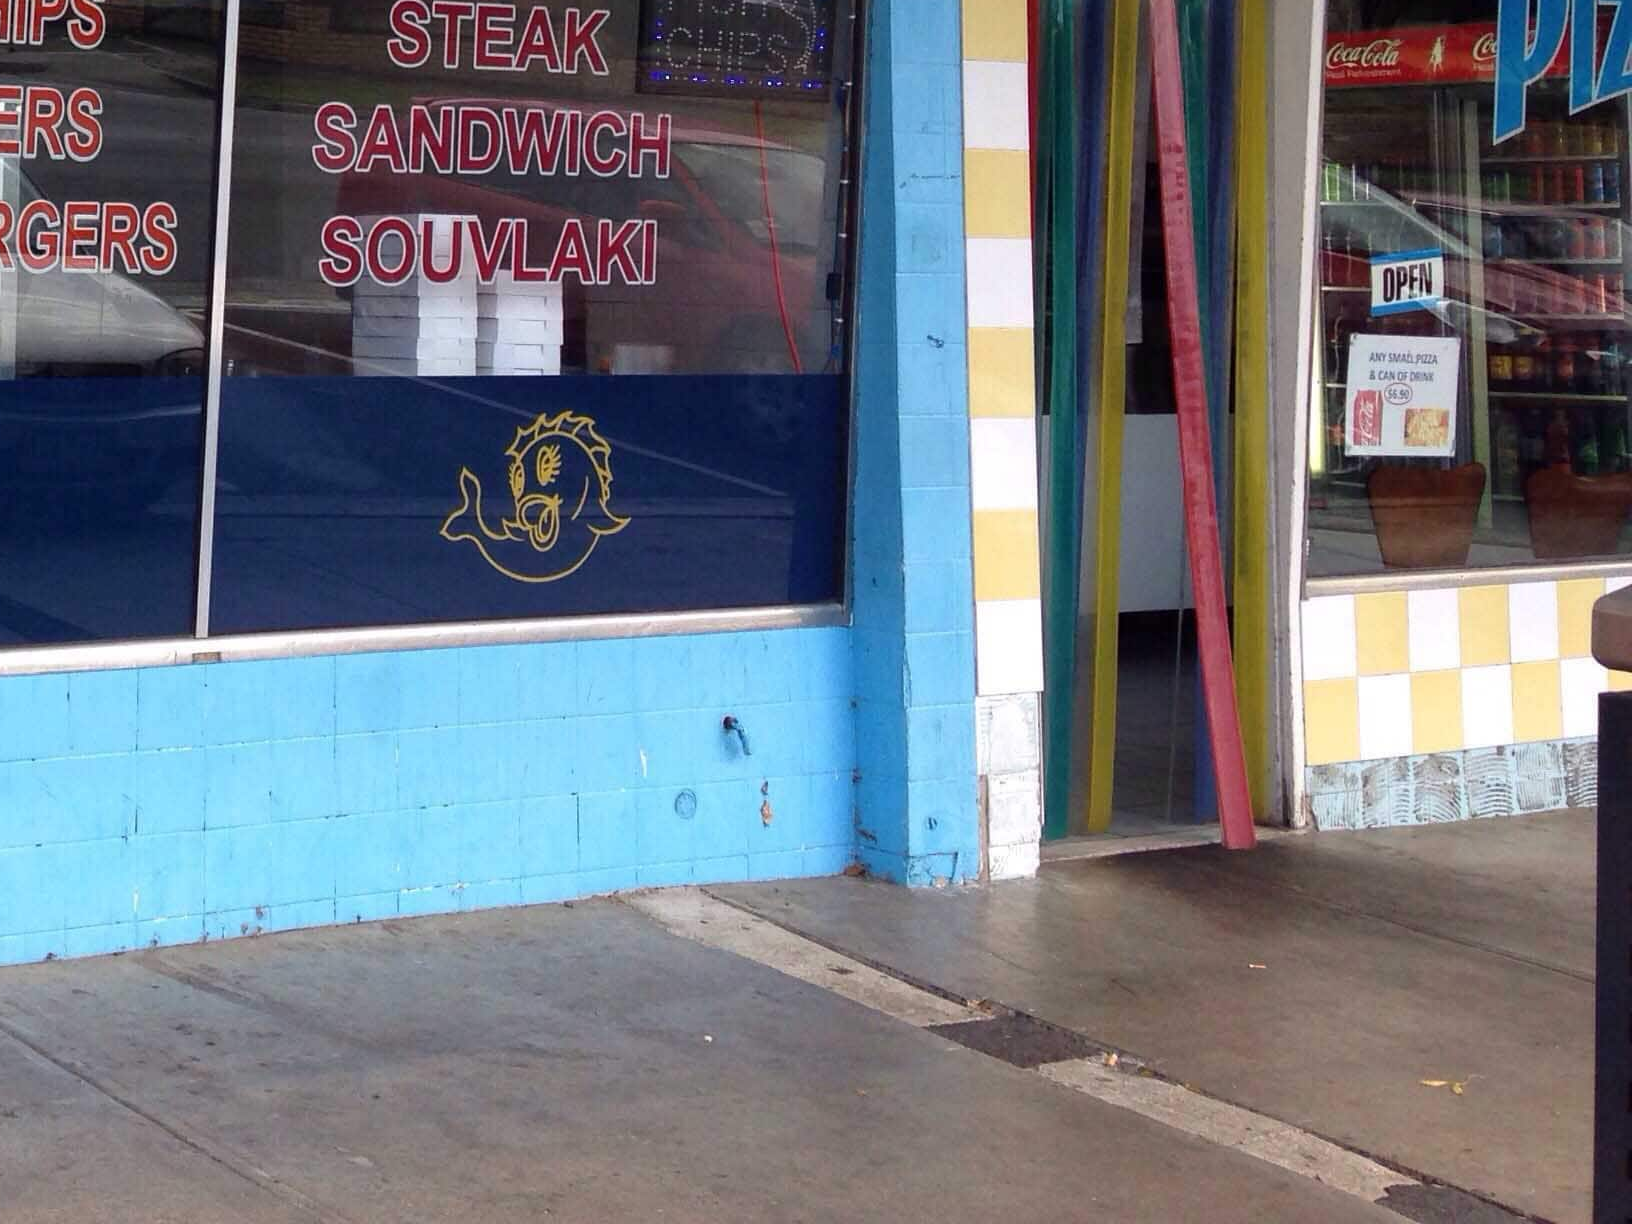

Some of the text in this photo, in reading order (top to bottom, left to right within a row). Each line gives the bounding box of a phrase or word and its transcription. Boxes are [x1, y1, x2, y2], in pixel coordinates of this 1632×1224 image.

[666, 26, 788, 75] CHIPS
[311, 102, 673, 179] SANDWICH
[318, 216, 658, 287] SOUVLAKI
[1383, 262, 1432, 303] OPEN
[1369, 352, 1387, 362] ANY
[1416, 353, 1438, 365] PIZZA
[1378, 370, 1395, 381] CAN
[1397, 371, 1408, 382] OF
[1410, 371, 1434, 382] DRINK
